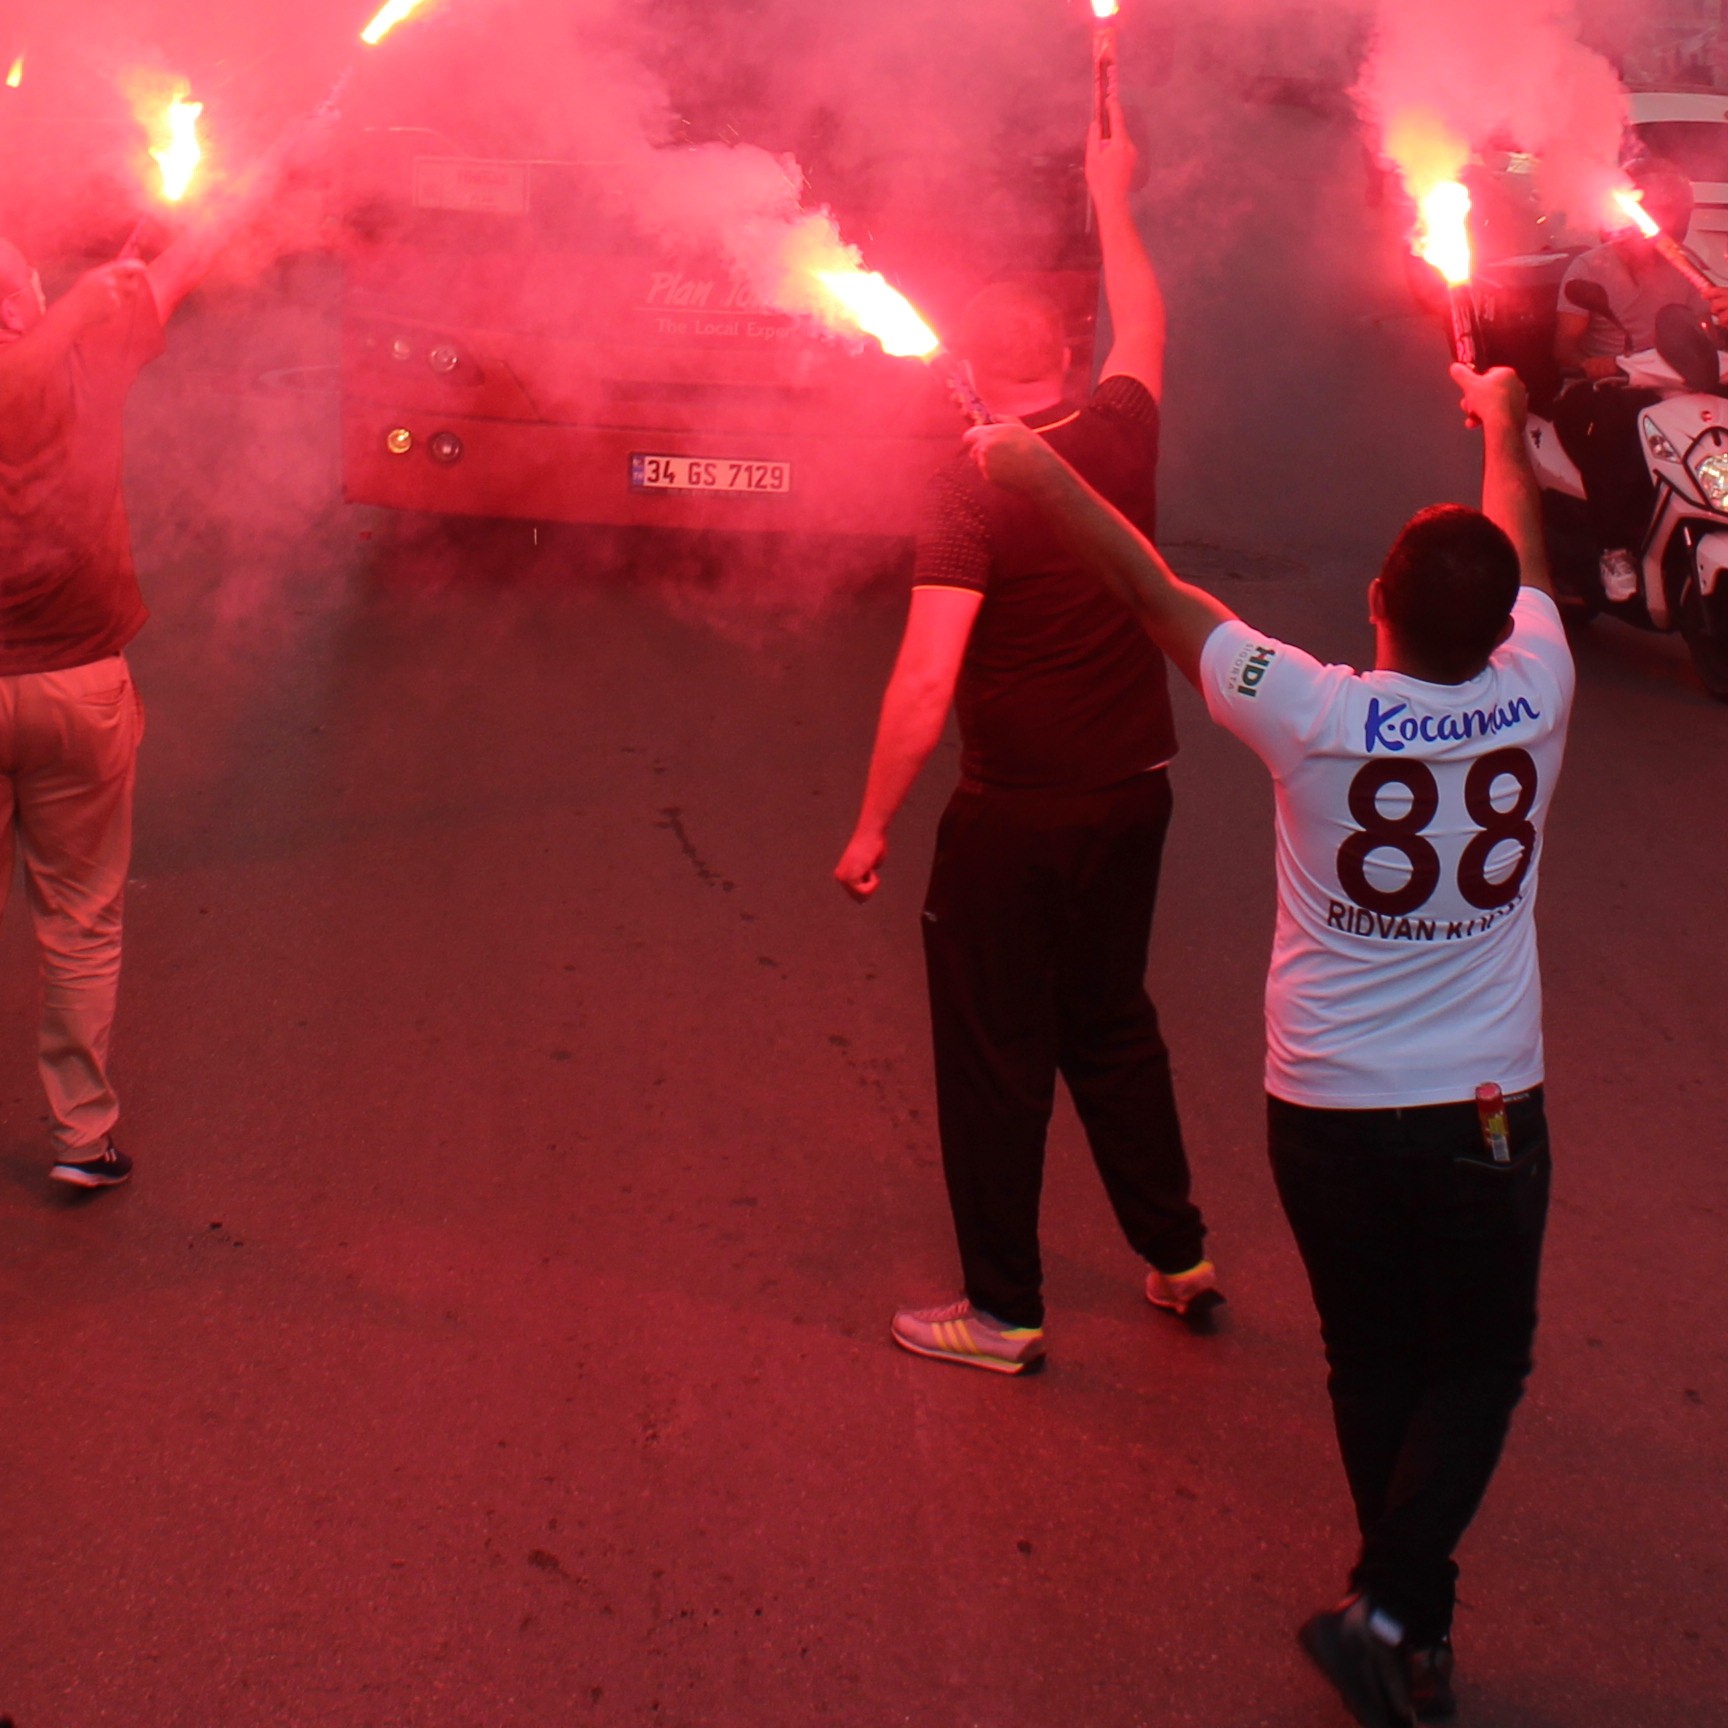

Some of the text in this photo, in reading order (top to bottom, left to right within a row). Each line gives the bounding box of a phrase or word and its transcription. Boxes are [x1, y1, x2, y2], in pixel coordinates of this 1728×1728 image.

[646, 271, 716, 309] Plan
[657, 319, 687, 334] The
[696, 320, 739, 336] Local
[647, 460, 675, 484] 34
[688, 462, 717, 486] GS
[729, 464, 784, 489] 7129
[1237, 646, 1276, 697] HDI
[1364, 693, 1540, 752] Kocaman
[1336, 747, 1538, 915] 88
[1327, 899, 1436, 941] RIDVAN
